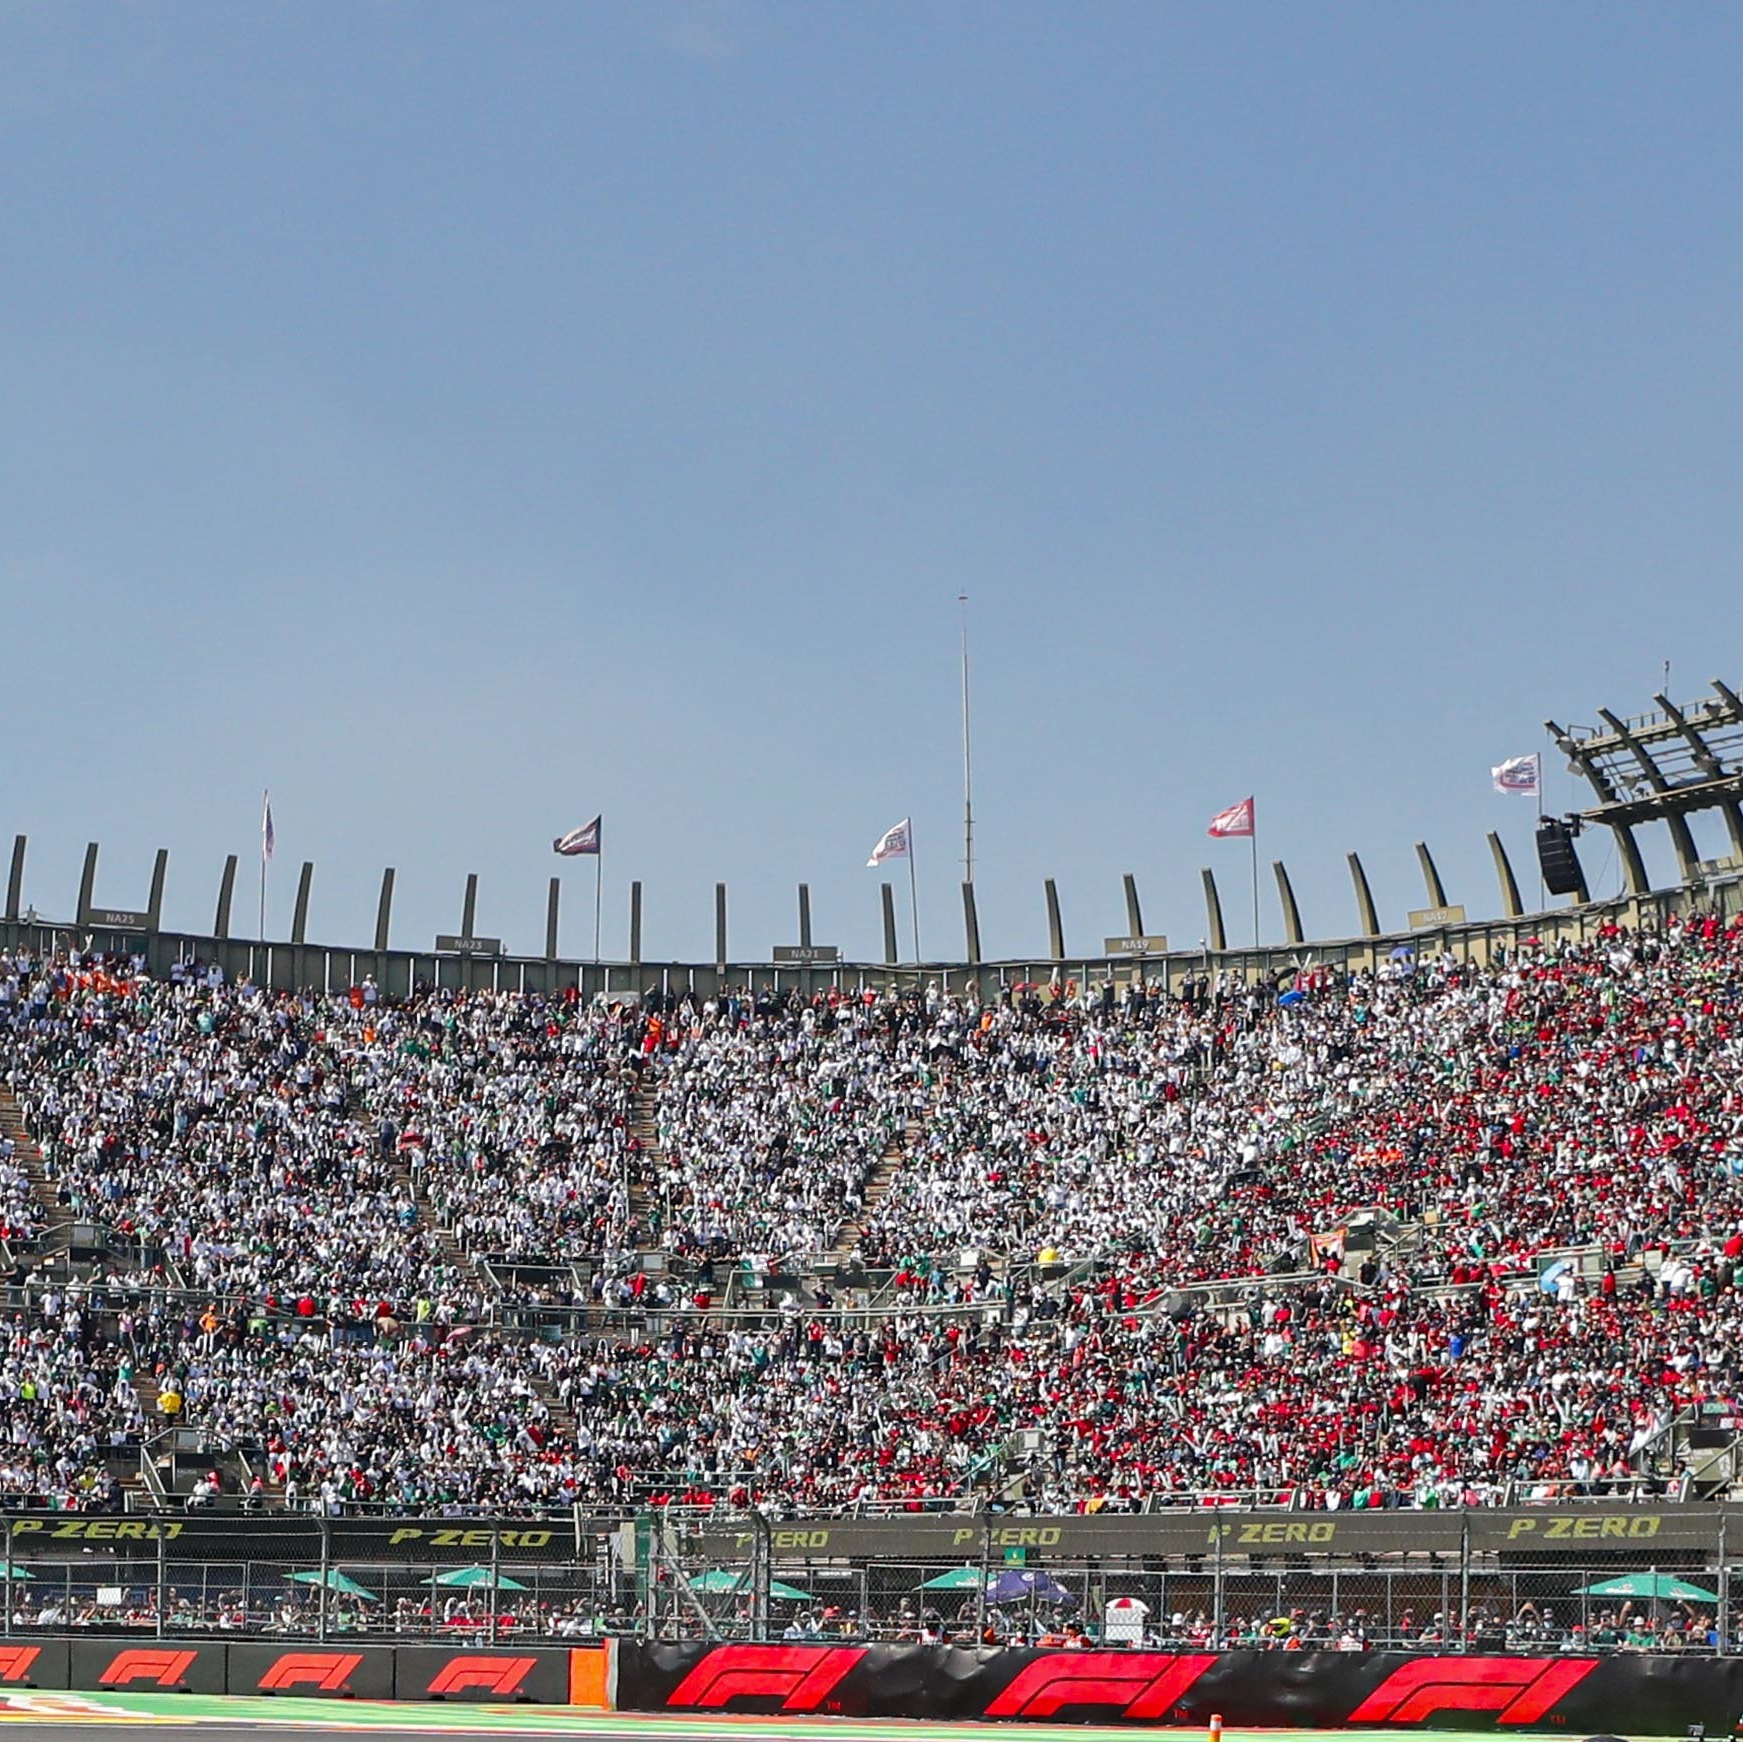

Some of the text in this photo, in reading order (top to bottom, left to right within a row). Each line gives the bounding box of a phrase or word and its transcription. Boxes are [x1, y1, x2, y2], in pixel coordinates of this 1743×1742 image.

[106, 912, 135, 924] NA25
[455, 939, 483, 950] NA23
[791, 949, 818, 958] NA21
[1122, 941, 1149, 950] NA19
[11, 1519, 183, 1540] P ZERO
[388, 1528, 552, 1547] P ZERO
[953, 1526, 1062, 1546] P ZERO
[1238, 1522, 1337, 1543] ZERO
[1508, 1516, 1662, 1539] P ZERO
[769, 1530, 829, 1548] ERO
[99, 1649, 199, 1686] F1
[258, 1653, 364, 1691] F1
[427, 1656, 538, 1695] F1
[667, 1645, 869, 1710] F1
[984, 1653, 1219, 1719] F1
[1347, 1656, 1600, 1724] F1
